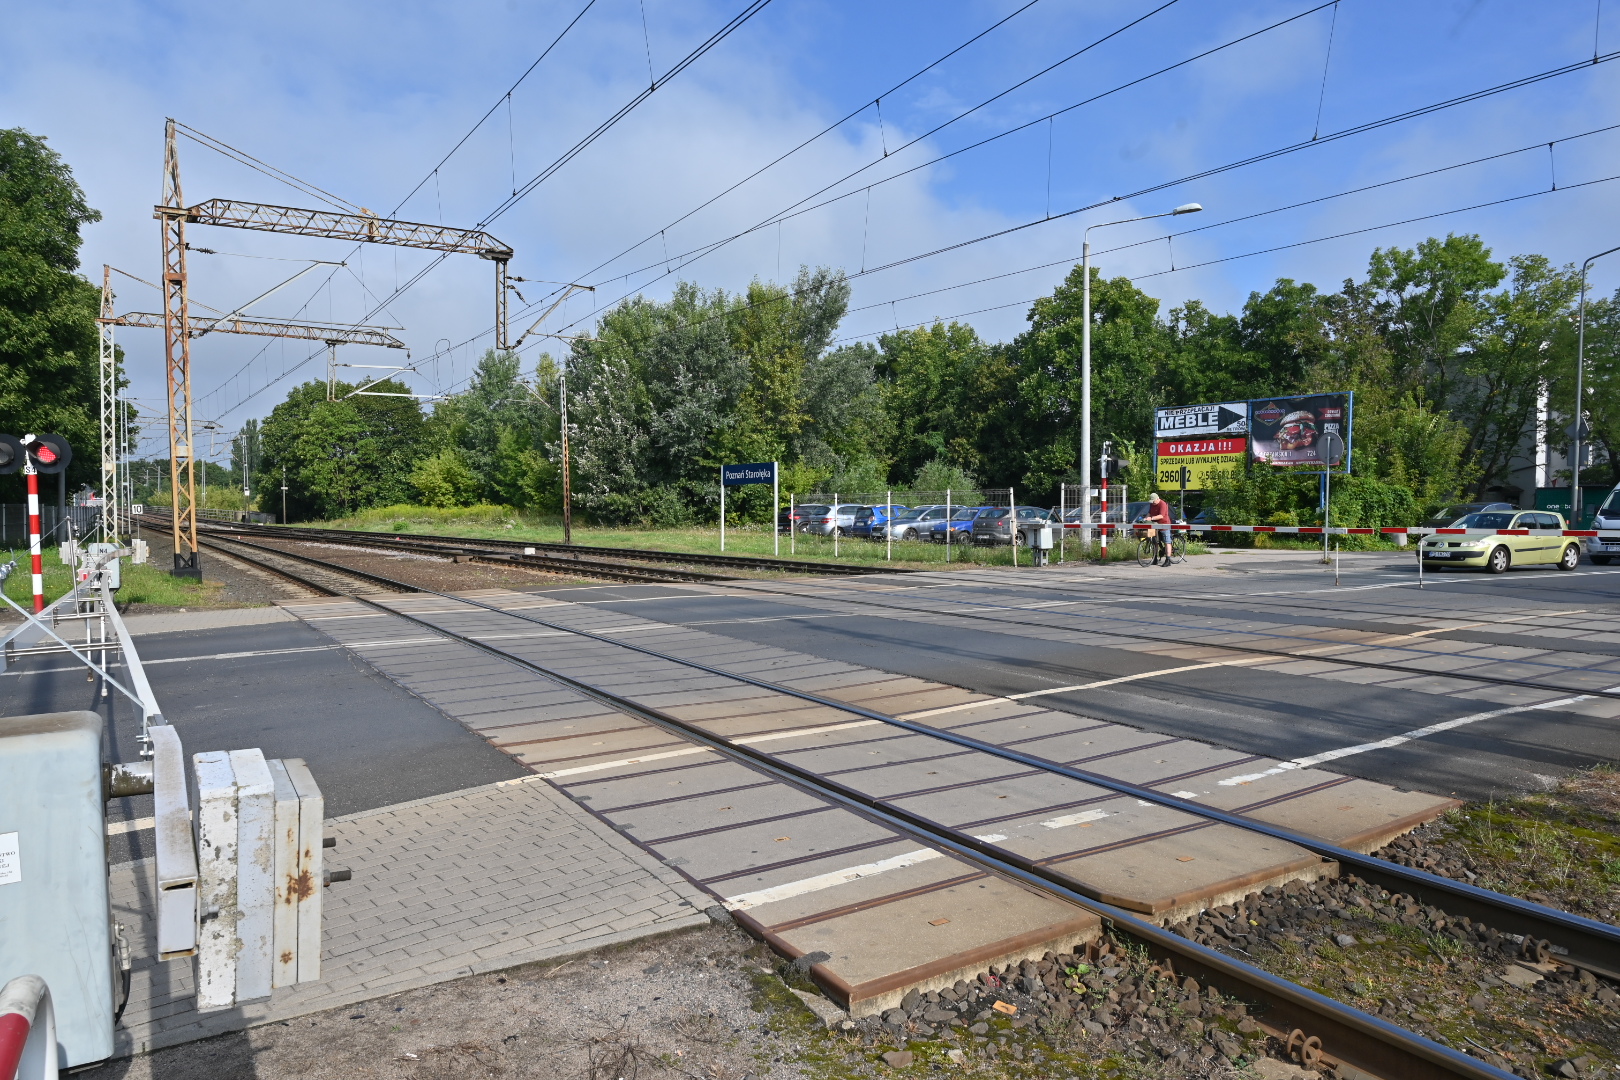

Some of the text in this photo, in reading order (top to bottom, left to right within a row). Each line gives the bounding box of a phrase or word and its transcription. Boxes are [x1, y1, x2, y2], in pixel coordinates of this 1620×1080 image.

[1160, 412, 1218, 430] MEBLE
[1236, 420, 1246, 428] 50
[1324, 422, 1340, 430] PIZZA
[1169, 442, 1215, 453] OKAZJA
[1160, 457, 1185, 465] SPRZEDAM
[1185, 457, 1195, 465] LUB
[1195, 456, 1220, 465] WYNAJMĘ
[725, 468, 771, 480] Poznań Starołęka
[132, 505, 142, 513] 10
